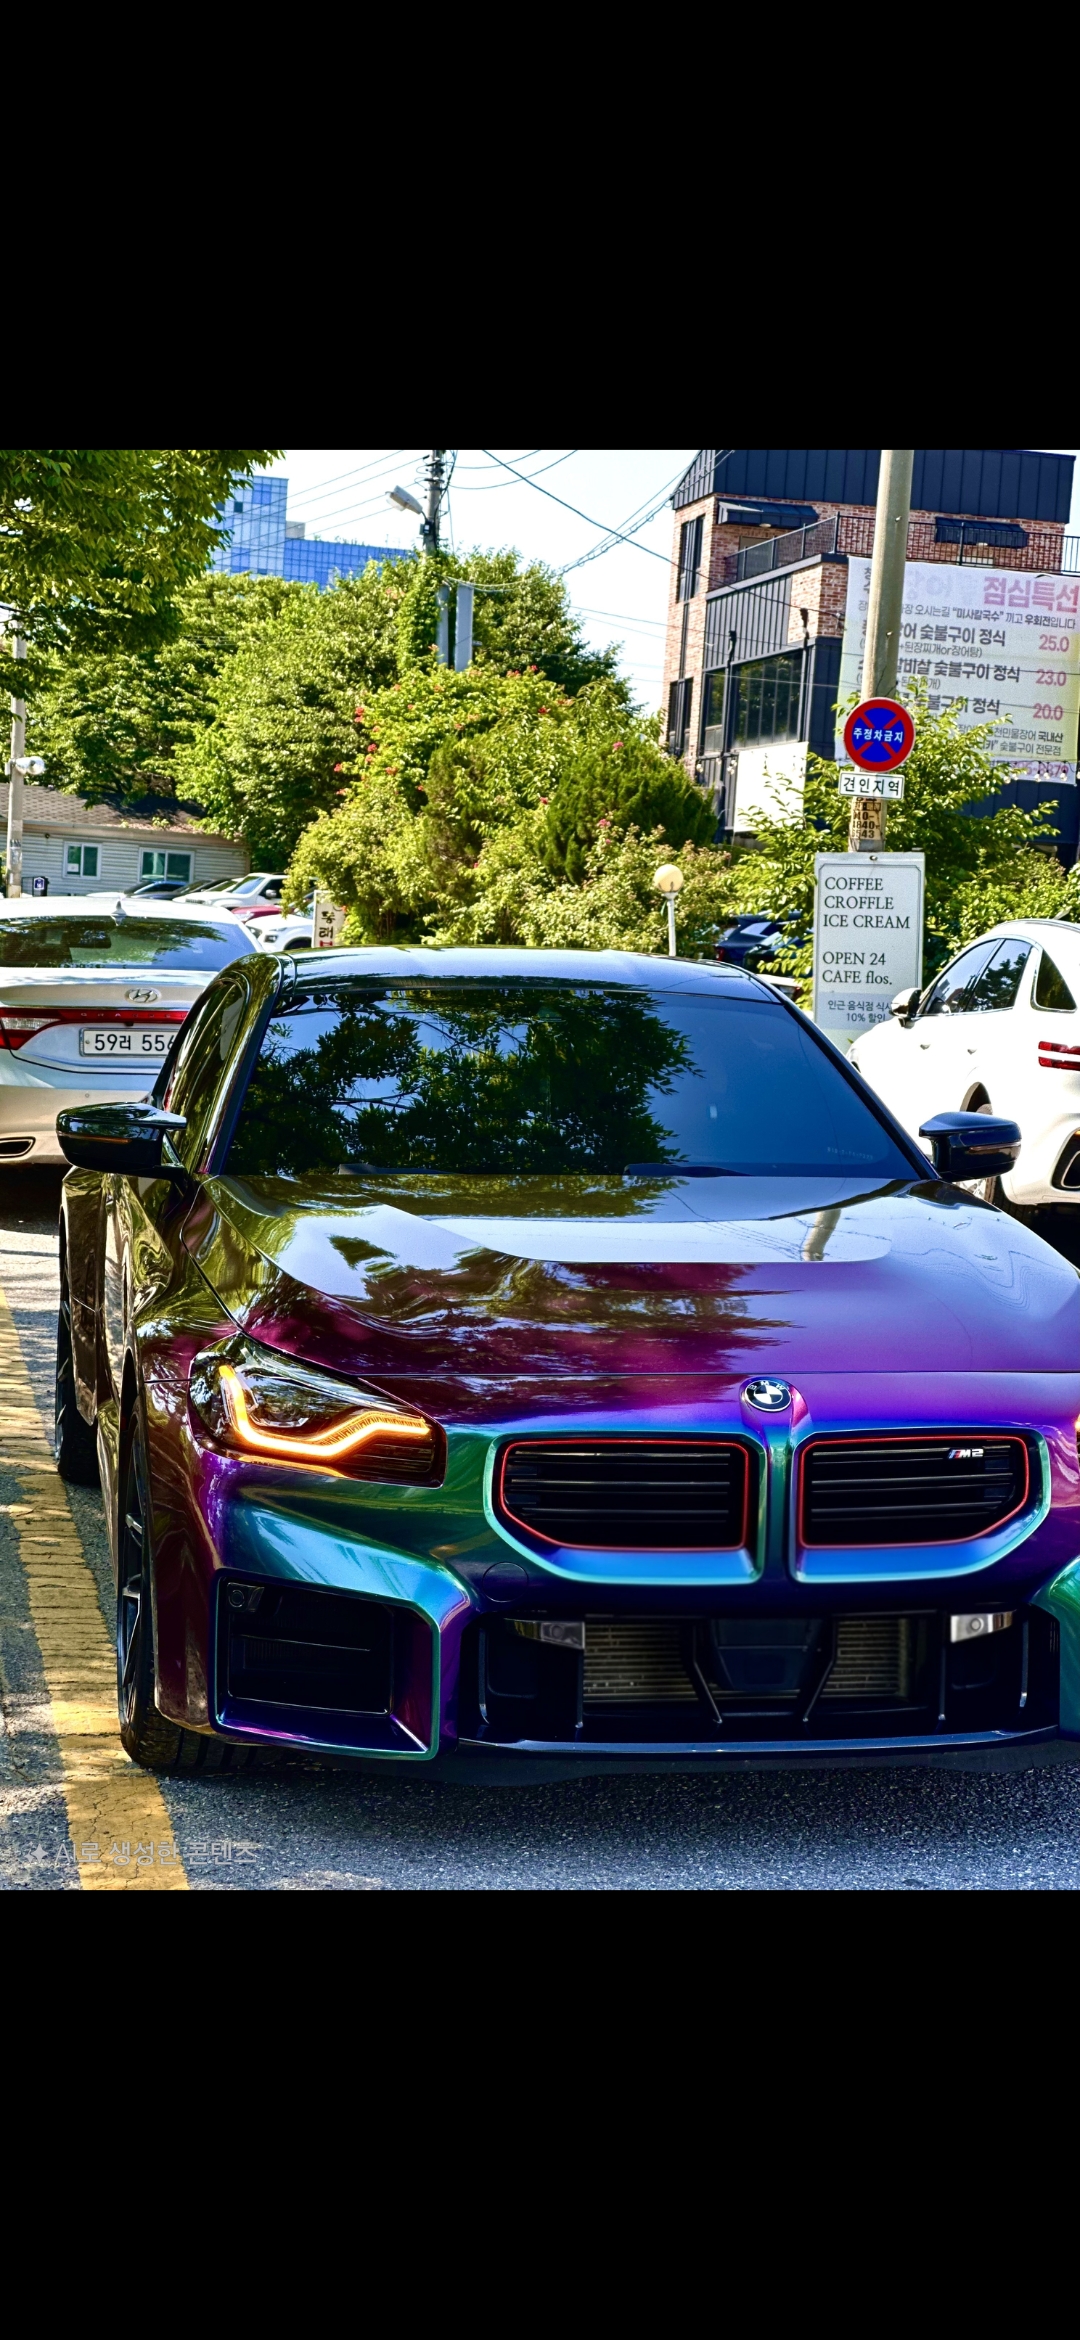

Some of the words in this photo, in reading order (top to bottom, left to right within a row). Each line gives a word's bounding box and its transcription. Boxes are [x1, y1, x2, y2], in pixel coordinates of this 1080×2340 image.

[984, 576, 1080, 613] 점심특선
[915, 604, 950, 617] 오시는길
[1025, 614, 1076, 629] 우회전입니다
[921, 624, 976, 644] 숯불구이
[979, 629, 1006, 647] 정식
[1039, 634, 1070, 653] 25.0
[934, 662, 989, 681] 숯불구이
[993, 665, 1021, 683] 정식
[1036, 669, 1067, 687] 23.0
[972, 697, 1001, 716] 정식
[1033, 703, 1064, 721] 20.0
[853, 727, 903, 743] 주정차금지
[1038, 731, 1064, 743] 국내산
[1000, 741, 1034, 753] 숯불구이
[1036, 744, 1062, 757] 전문점
[843, 776, 899, 796] 견인지역
[824, 876, 884, 891] COFFEE
[824, 895, 895, 910] CROFFLE
[823, 914, 849, 928] ICE
[852, 914, 911, 929] CREAM
[822, 951, 866, 966] OPEN
[869, 952, 887, 966] 24
[822, 969, 862, 984] CAFE
[865, 969, 893, 986] flos.
[827, 1000, 846, 1011] 인근
[847, 1000, 874, 1012] 음식점
[846, 1012, 866, 1022] 10%
[94, 1034, 131, 1051] 59러
